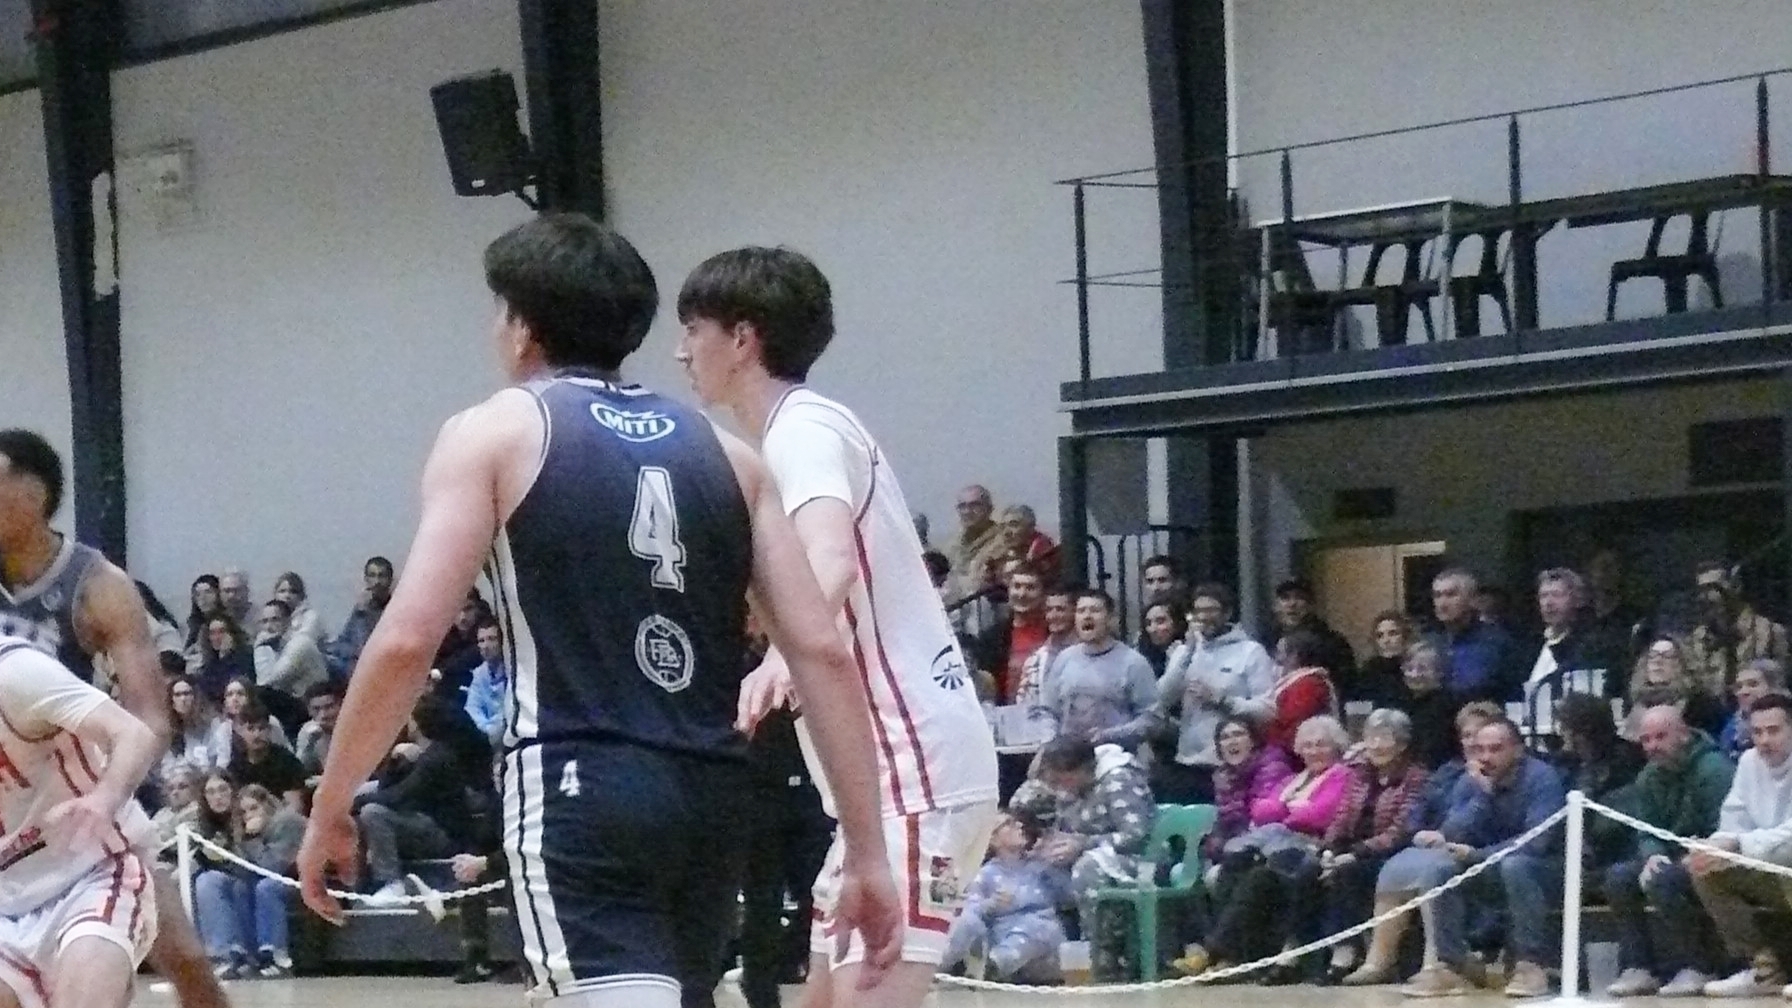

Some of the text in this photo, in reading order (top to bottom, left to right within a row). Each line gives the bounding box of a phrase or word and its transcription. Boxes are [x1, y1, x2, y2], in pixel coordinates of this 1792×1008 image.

[603, 411, 658, 435] MITI
[628, 466, 687, 594] 4
[559, 759, 581, 797] 4
